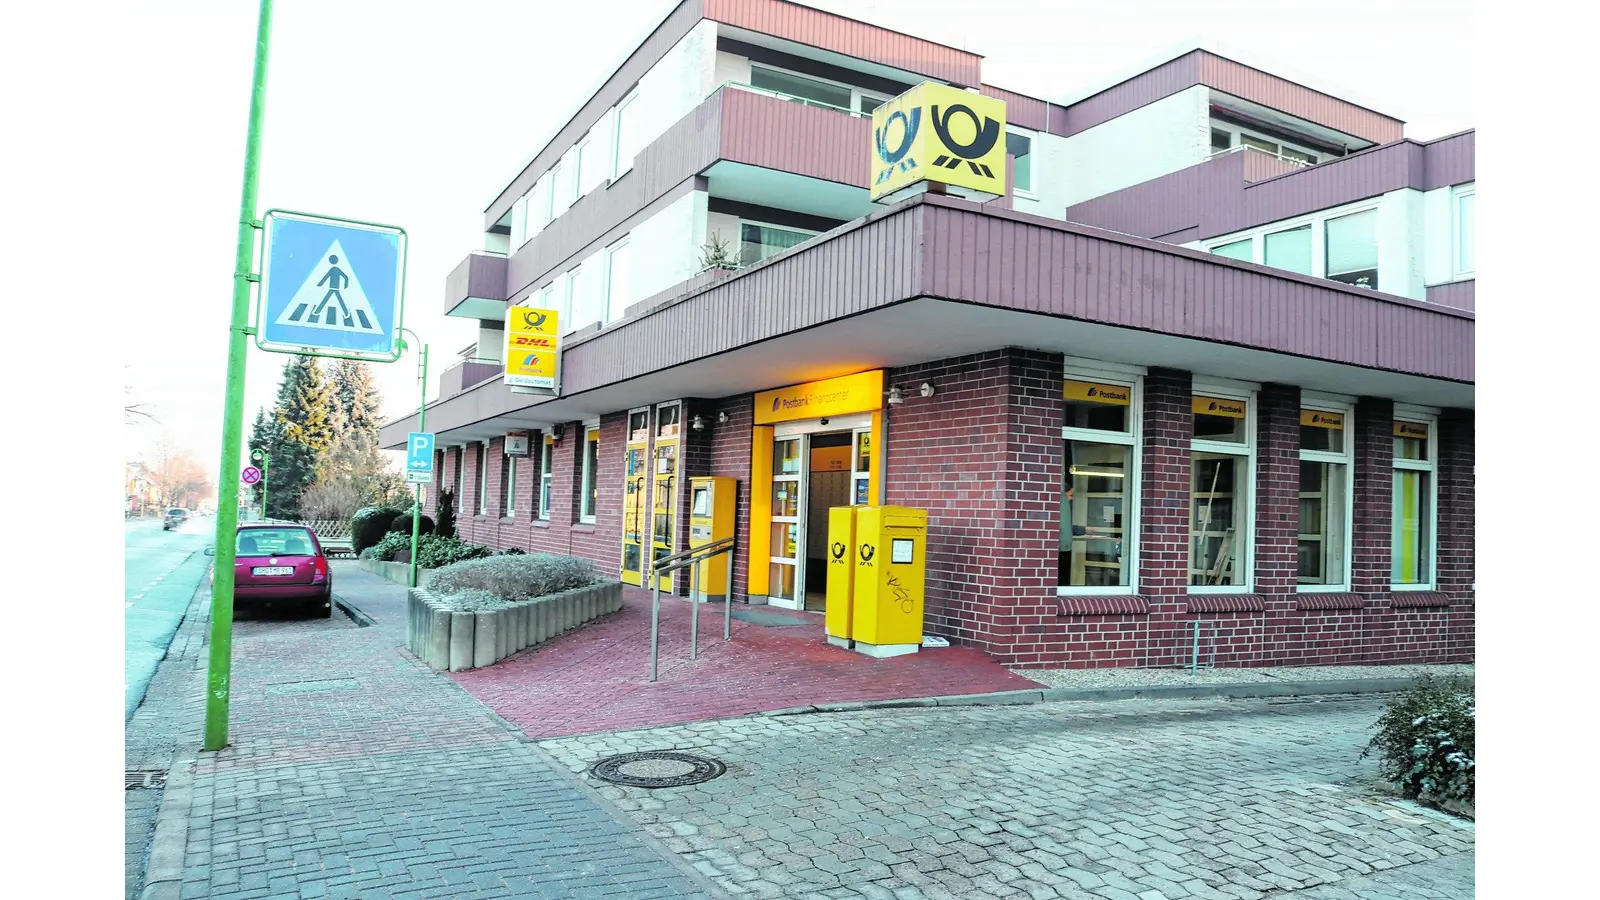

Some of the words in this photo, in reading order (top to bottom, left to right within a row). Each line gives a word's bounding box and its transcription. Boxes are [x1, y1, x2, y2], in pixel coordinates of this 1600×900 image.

[516, 337, 550, 347] DHL
[514, 377, 552, 386] Geldautomat
[1099, 390, 1127, 400] Postbank
[782, 395, 809, 410] Postbank
[1218, 404, 1243, 413] Postbank
[413, 436, 429, 457] P
